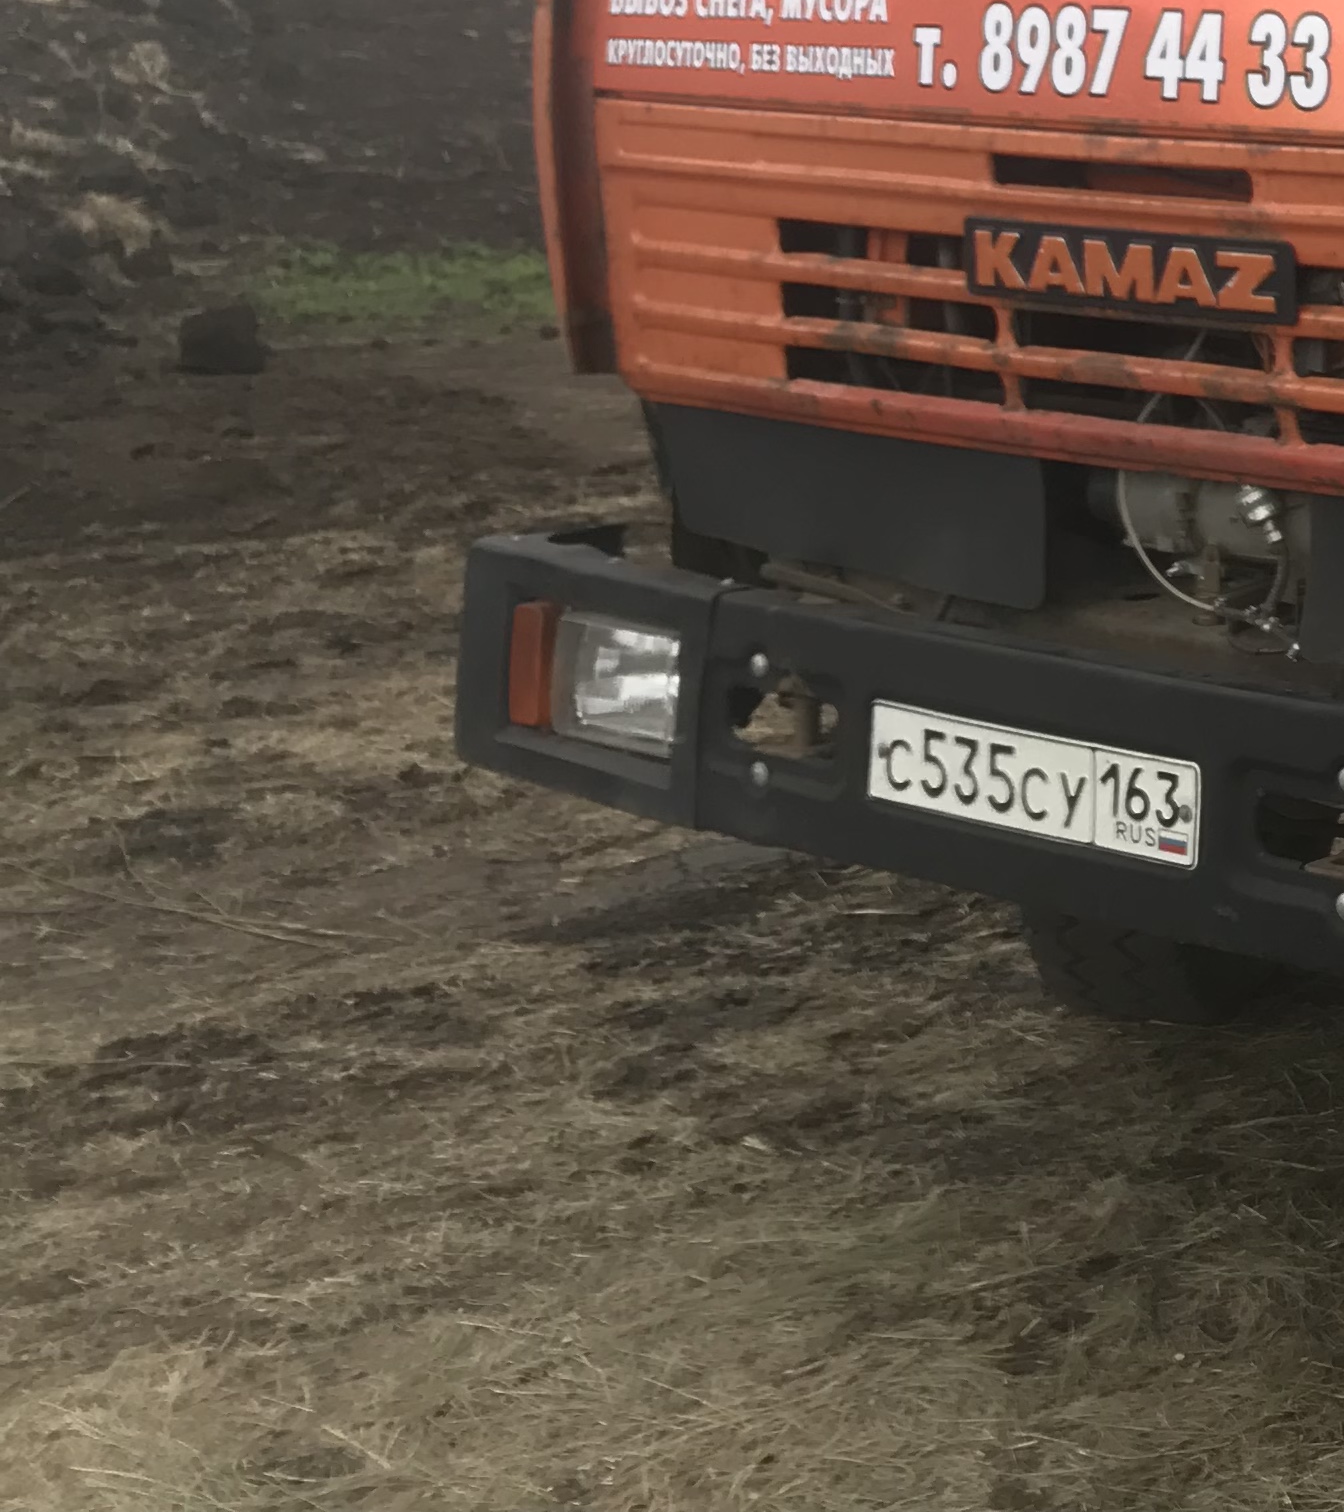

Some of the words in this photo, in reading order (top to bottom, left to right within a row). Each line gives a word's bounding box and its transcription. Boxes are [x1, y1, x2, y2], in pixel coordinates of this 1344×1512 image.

[606, 38, 746, 75] КРУГЛОСУТОЧНО,
[749, 44, 781, 73] БЕЗ
[786, 46, 896, 79] ВЫХОДНЫХ
[980, 1, 1130, 97] 8987
[1145, 8, 1226, 102] 44
[1247, 11, 1331, 110] 33
[973, 229, 1277, 313] KAMAZ
[1116, 821, 1156, 847] RUS
